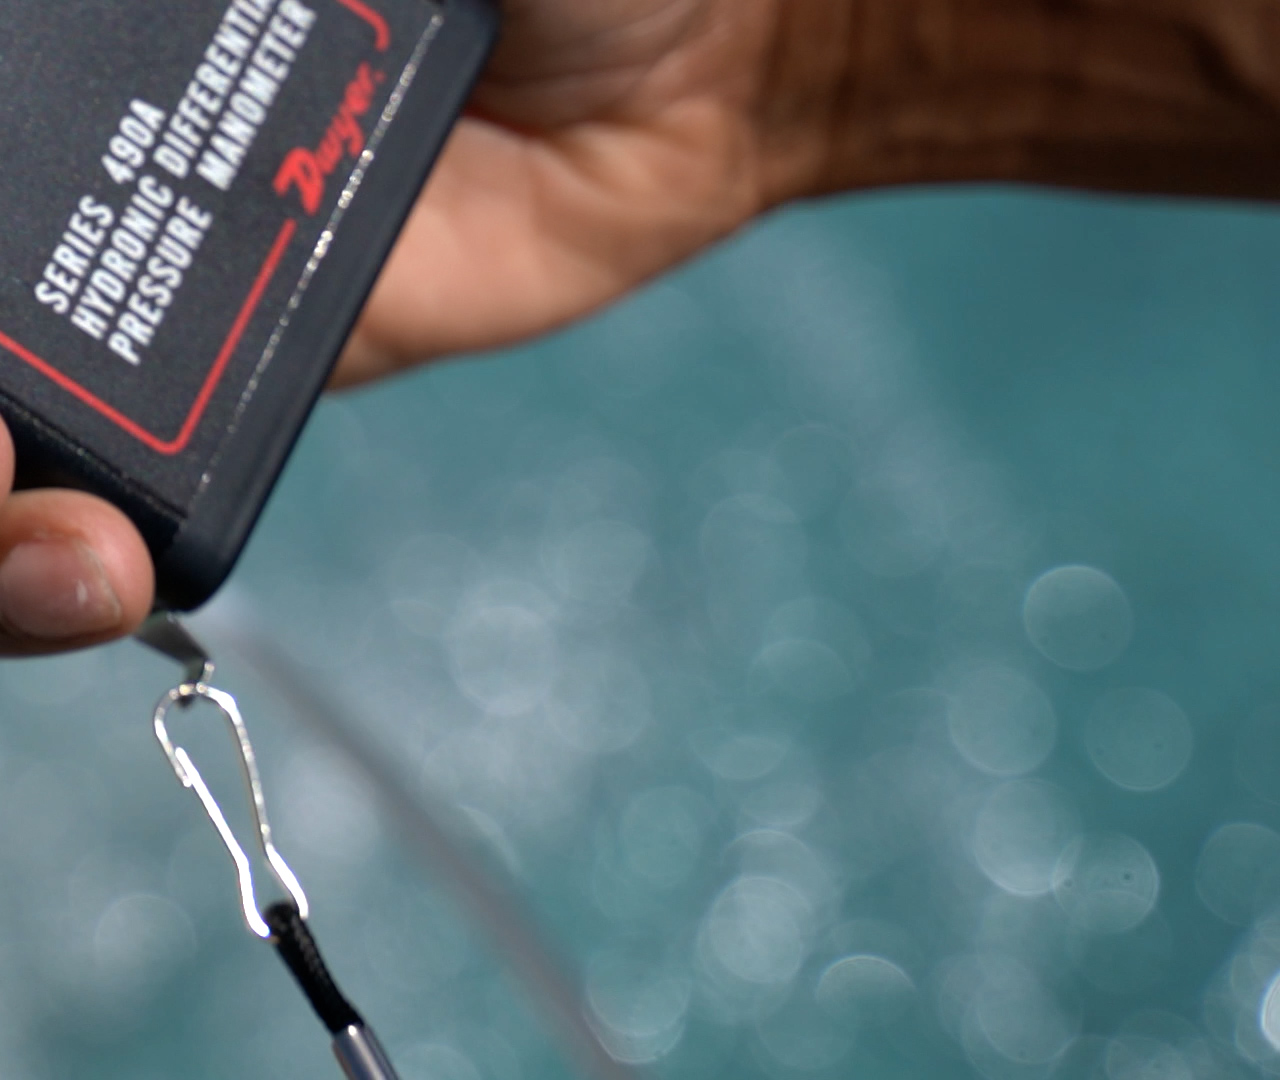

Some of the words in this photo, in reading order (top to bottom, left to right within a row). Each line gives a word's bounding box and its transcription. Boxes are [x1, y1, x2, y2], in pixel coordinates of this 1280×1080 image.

[34, 195, 114, 314] SERIES
[101, 98, 167, 184] 490A
[70, 174, 174, 340] HYDRONIC
[107, 196, 213, 366] PRESSURE
